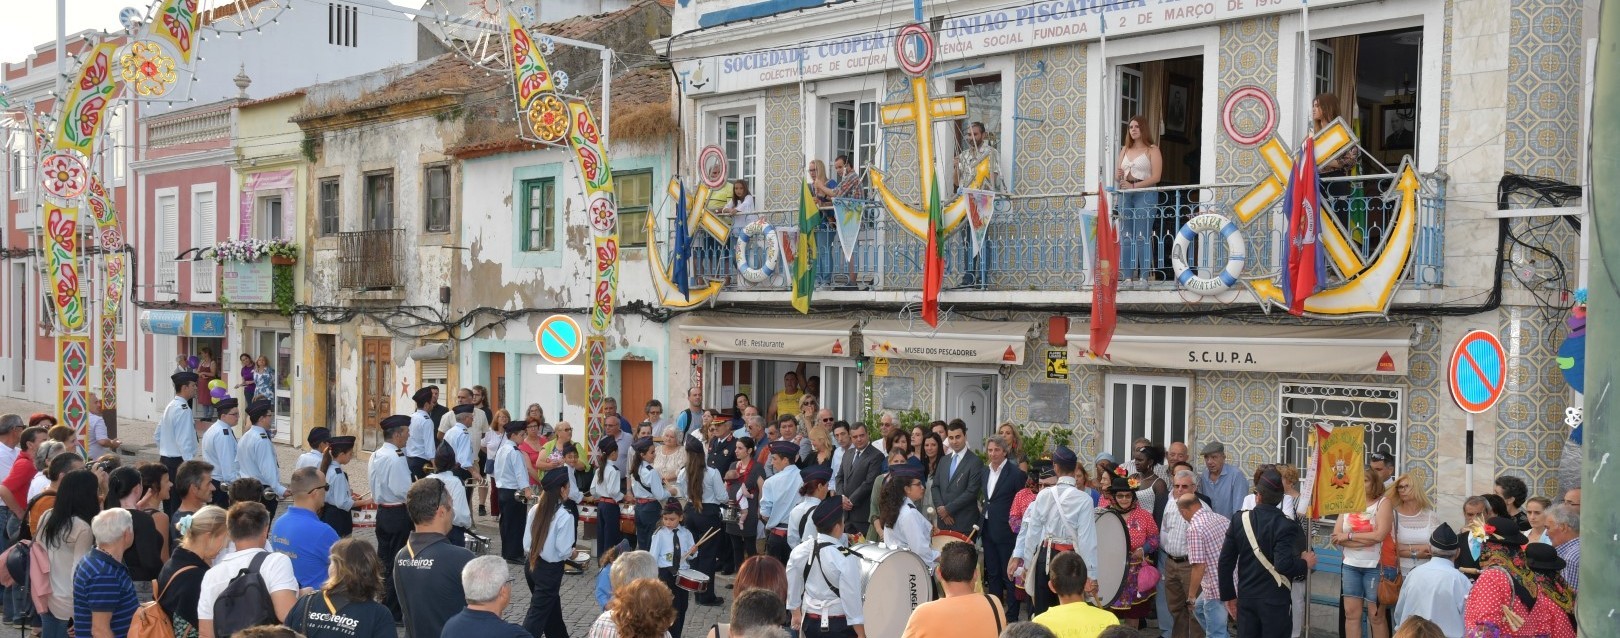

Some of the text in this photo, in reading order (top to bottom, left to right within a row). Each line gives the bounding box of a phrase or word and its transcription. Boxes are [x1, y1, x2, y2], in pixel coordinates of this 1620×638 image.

[760, 63, 822, 81] COLECTIVDADE
[829, 61, 840, 71] DE
[847, 53, 887, 68] CULTURA
[983, 33, 1023, 48] SOCIAL
[1034, 22, 1087, 40] FUNDADA
[1119, 16, 1126, 27] 2
[1137, 12, 1152, 25] DE
[1164, 2, 1214, 20] MARÇO
[1227, 0, 1243, 11] DE
[724, 46, 810, 74] SOCIEDADE
[734, 338, 785, 349] Café Restaurante
[905, 346, 977, 357] MUSEU DOS PESCADORES
